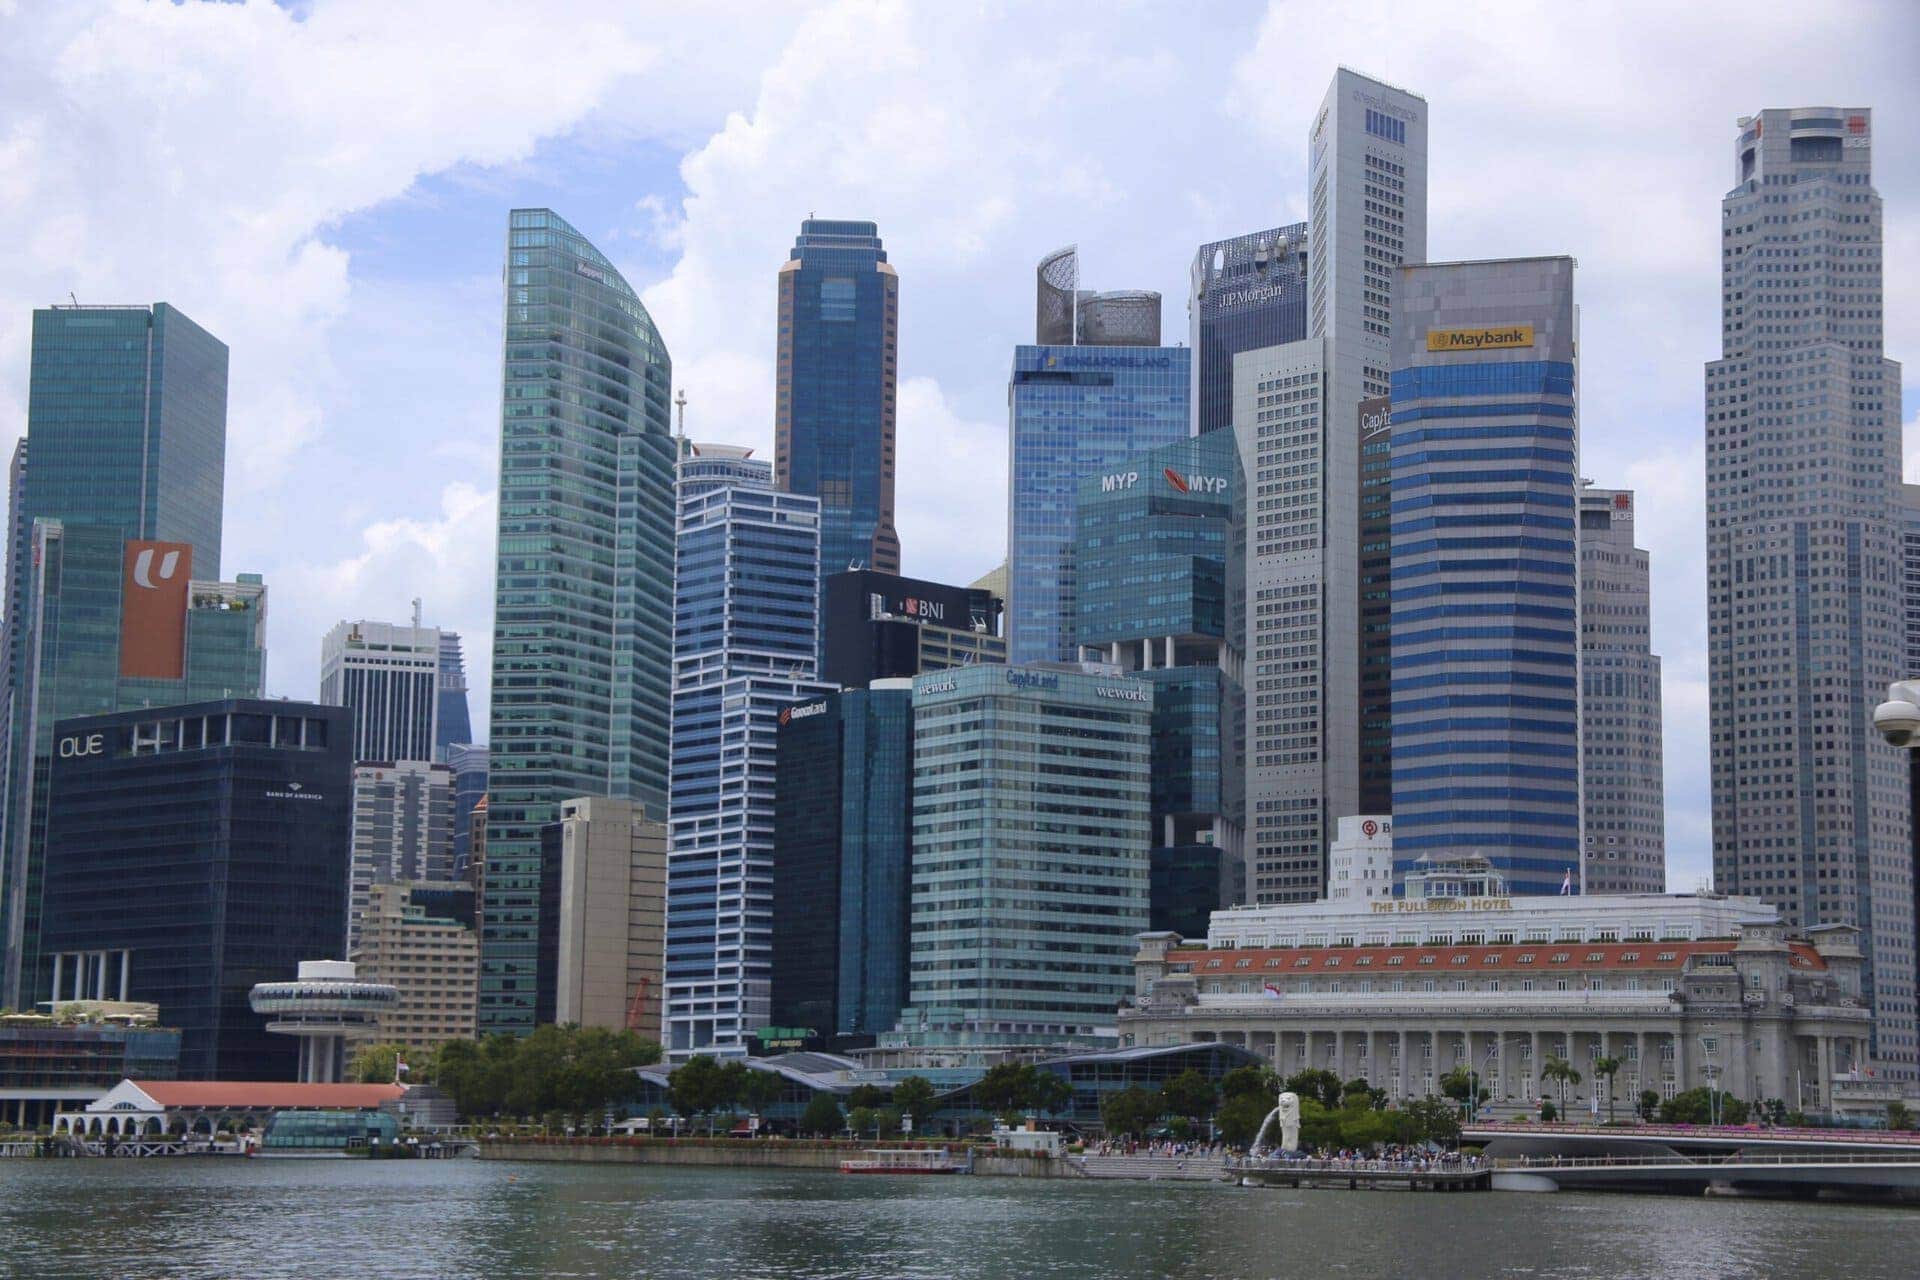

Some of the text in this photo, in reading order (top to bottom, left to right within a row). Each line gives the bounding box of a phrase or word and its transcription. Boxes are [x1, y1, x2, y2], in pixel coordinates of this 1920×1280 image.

[1450, 329, 1525, 347] Maybank
[1102, 472, 1138, 492] MYP
[1188, 475, 1228, 494] MYP
[920, 600, 944, 619] BNI
[919, 678, 956, 696] wework
[1096, 685, 1147, 702] wework
[60, 734, 103, 758] OUE
[1371, 899, 1513, 912] THE FULLERTON HOTEL
